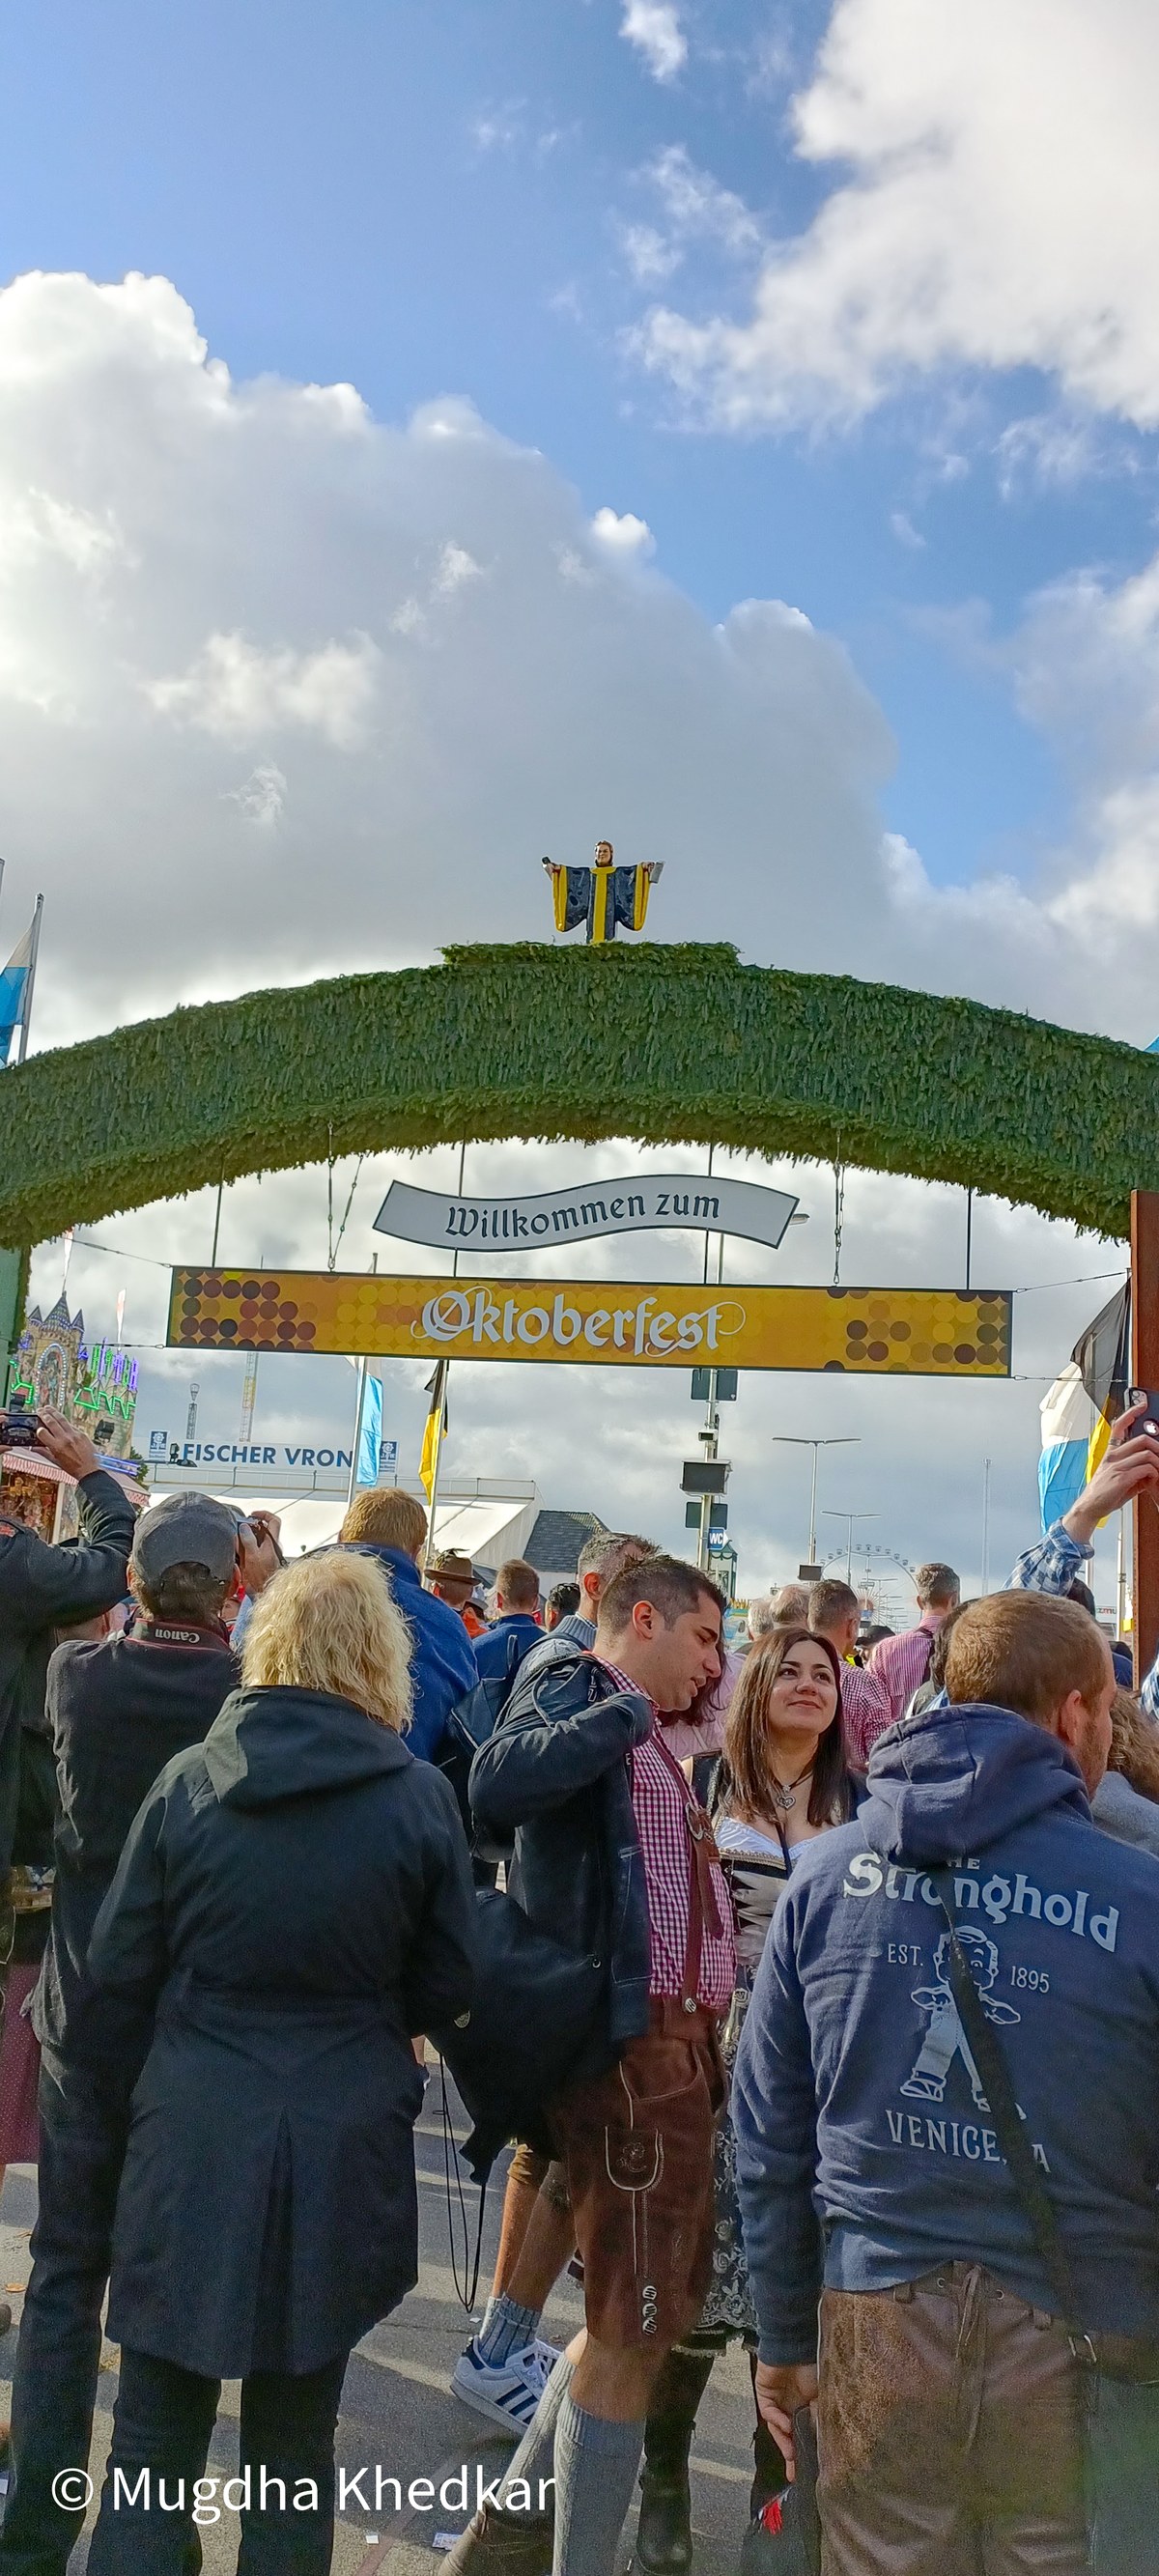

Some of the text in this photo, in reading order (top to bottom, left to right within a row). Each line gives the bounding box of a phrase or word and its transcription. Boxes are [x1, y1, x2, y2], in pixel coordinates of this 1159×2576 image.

[445, 1194, 720, 1238] Willkommen zum
[410, 1287, 747, 1358] Oktoberfest
[184, 1443, 276, 1464] FISCHER
[285, 1447, 353, 1467] VRON
[710, 1532, 723, 1544] WC
[155, 1629, 200, 1643] Canon
[947, 1855, 980, 1870] HE
[842, 1853, 1119, 1953] Stronghold
[888, 1943, 924, 1967] EST.
[1010, 1966, 1051, 1995] 1895
[886, 2110, 1051, 2173] VENICE, A
